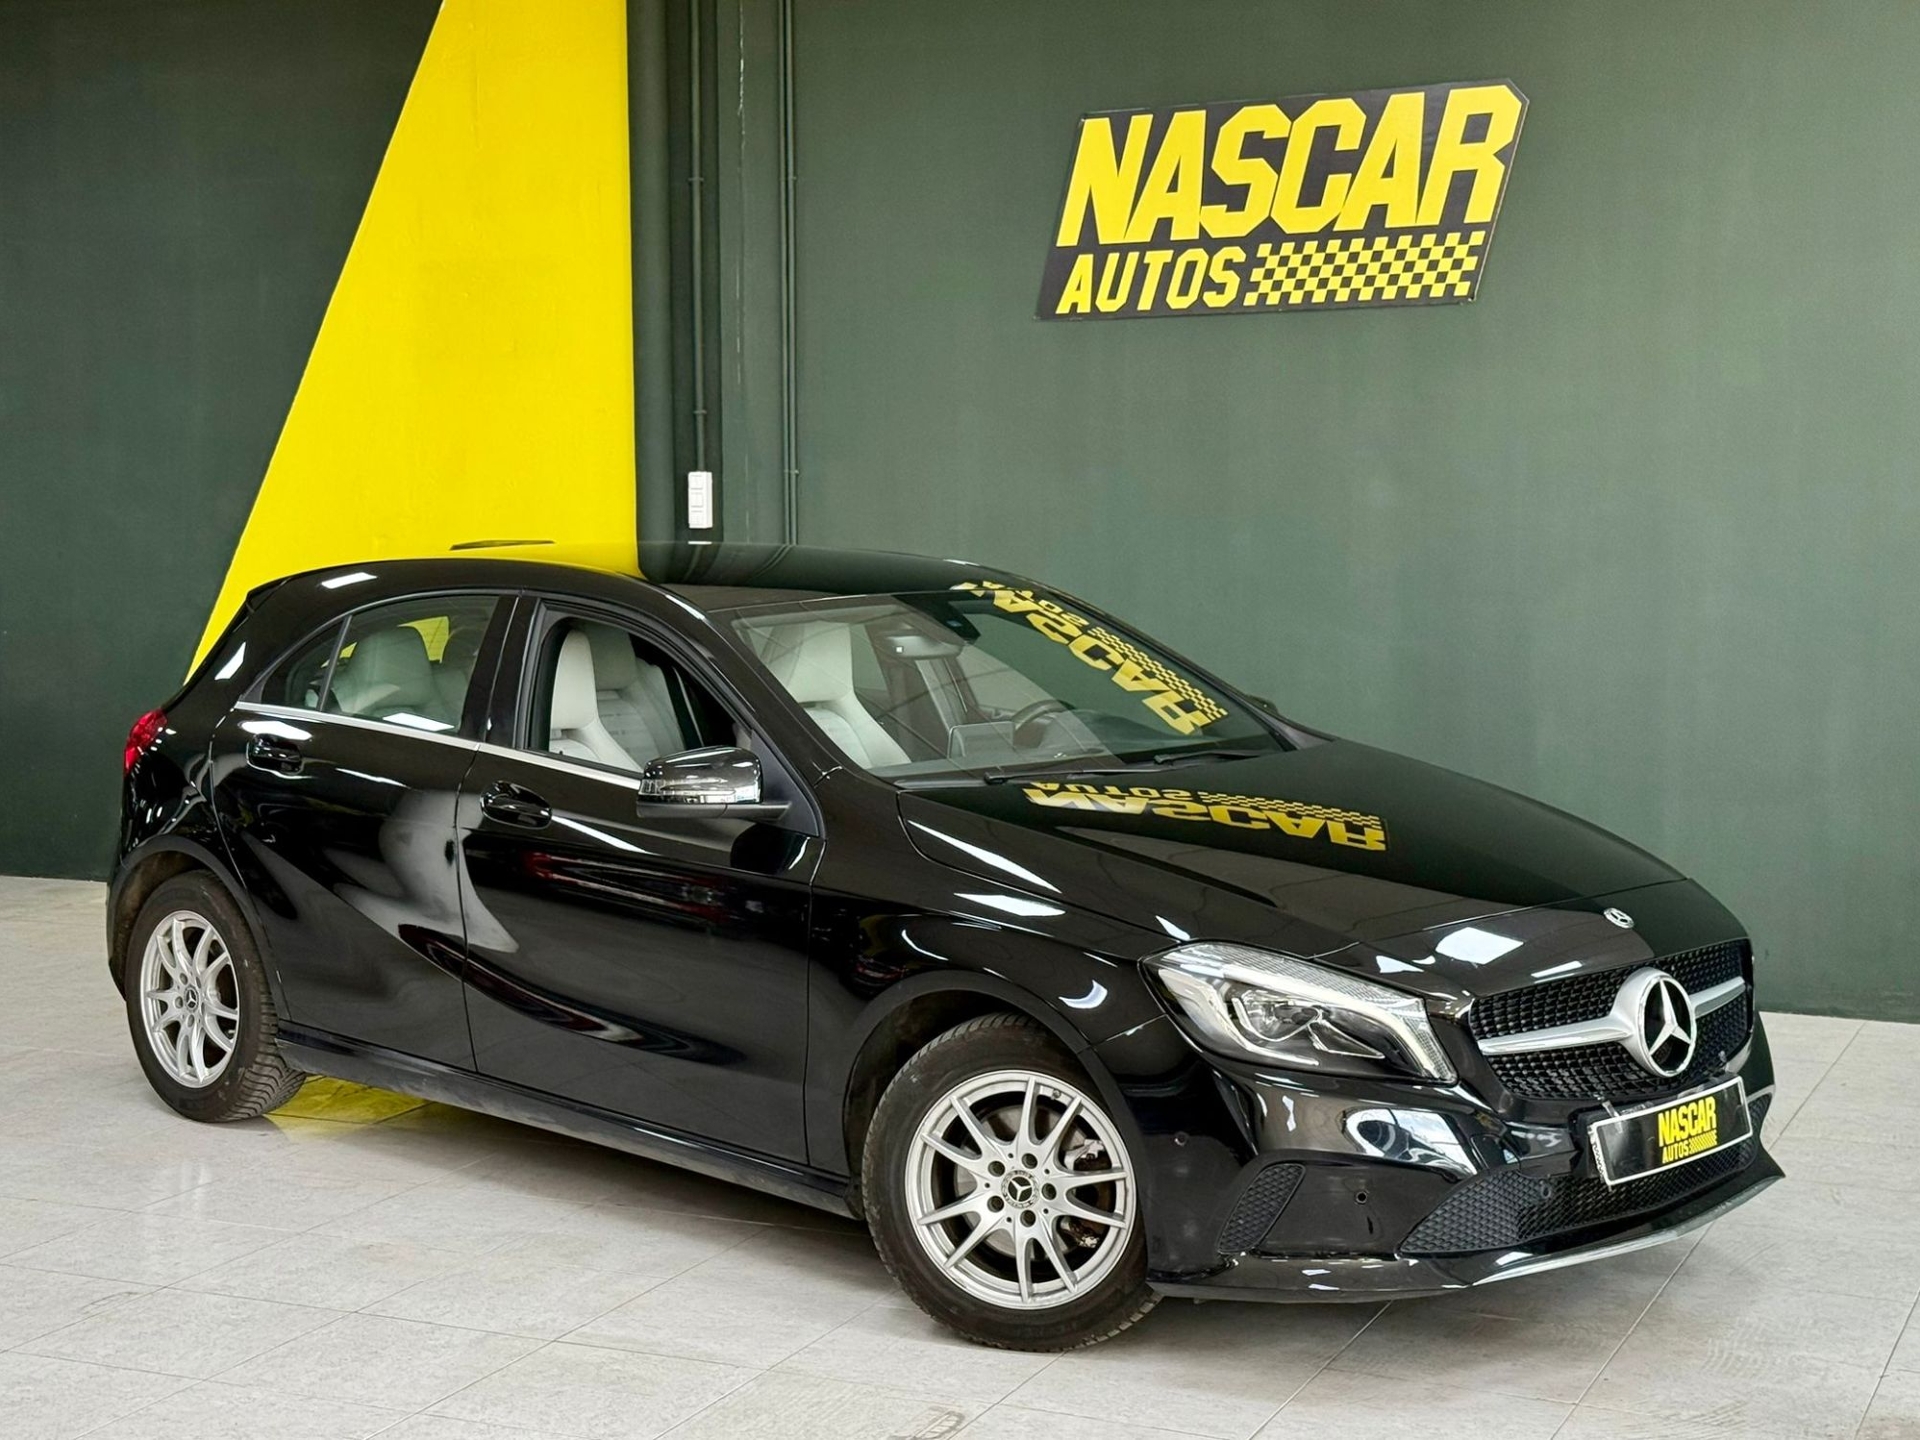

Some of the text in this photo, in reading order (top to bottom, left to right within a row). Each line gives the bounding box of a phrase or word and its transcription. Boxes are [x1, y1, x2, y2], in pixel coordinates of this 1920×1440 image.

[1056, 85, 1522, 247] NASCAR
[1056, 247, 1246, 314] AUTOS
[1658, 1096, 1717, 1147] NASCAR
[1662, 1140, 1689, 1164] AUTOS
